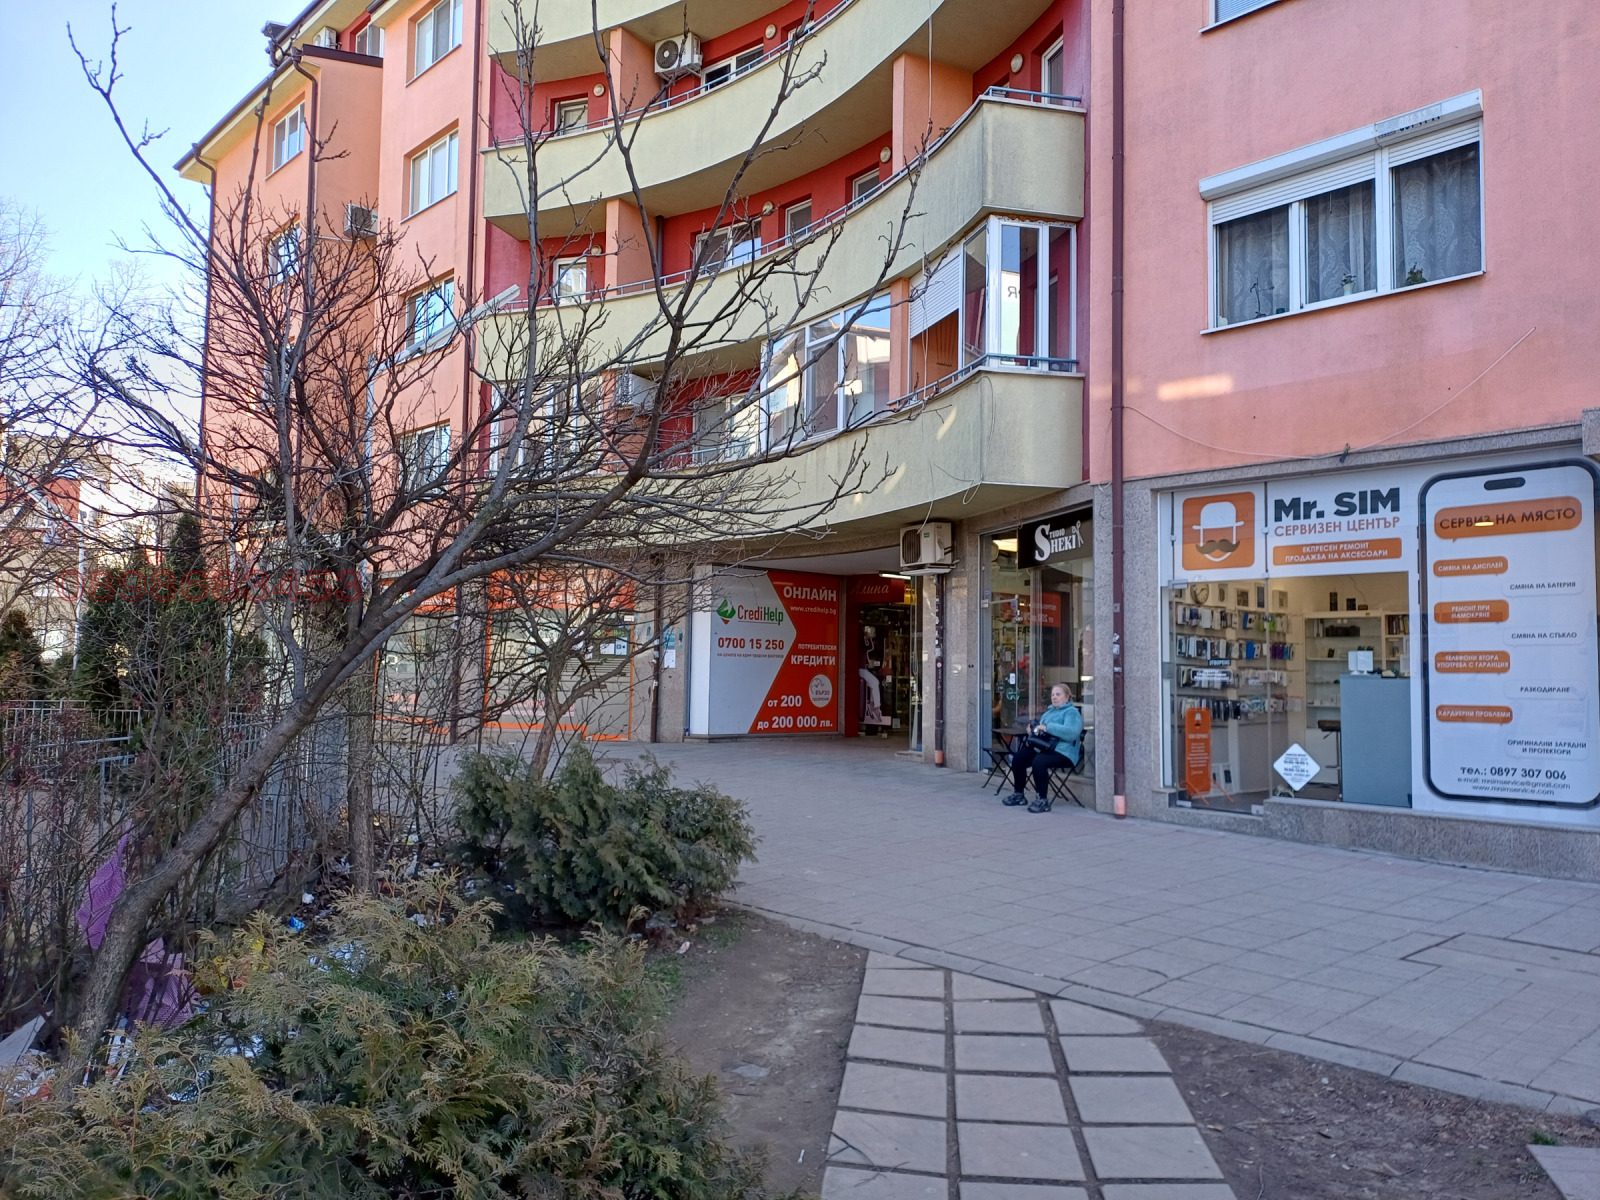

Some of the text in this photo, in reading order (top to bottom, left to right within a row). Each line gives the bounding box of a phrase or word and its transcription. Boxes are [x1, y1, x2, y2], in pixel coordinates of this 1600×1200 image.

[1274, 487, 1401, 523] Mr. SIM
[1439, 507, 1577, 530] СЕРВИЗ НА МЯСТО
[1274, 517, 1401, 537] СЕРВИЗЕН ЦЕНТЪР
[1302, 542, 1370, 553] ЕКПРЕСЕН РЕМОНТ
[1285, 550, 1388, 563] ПРОДАЖБА НА АКСЕСОАРИ
[1438, 561, 1504, 572] СМЯНА НА ДИСПЛЕЙ
[1547, 581, 1576, 589] БАТЕРИЯ
[783, 586, 837, 602] ОНЛАЙН
[737, 605, 784, 626] CrediHelp
[790, 606, 837, 615] www.credihelp.bg
[1511, 632, 1536, 640] СМЯНА
[1549, 631, 1577, 639] СТЪКЛО
[717, 637, 785, 650] 0700 15 250
[790, 655, 836, 667] КРЕДИТИ
[1519, 686, 1571, 694] РАЗКОДИРАНЕ
[767, 698, 778, 708] от
[780, 695, 802, 707] 200
[1475, 710, 1511, 718] ПРОБЛЕМИ
[757, 716, 833, 731] до 200 000 лв.
[1507, 739, 1587, 749] ОРИГИНАЛНИ ЗАРЯДНИ
[1528, 747, 1571, 755] ПРОТЕКТОРИ
[1460, 766, 1567, 780] тел.: 0897 307 006
